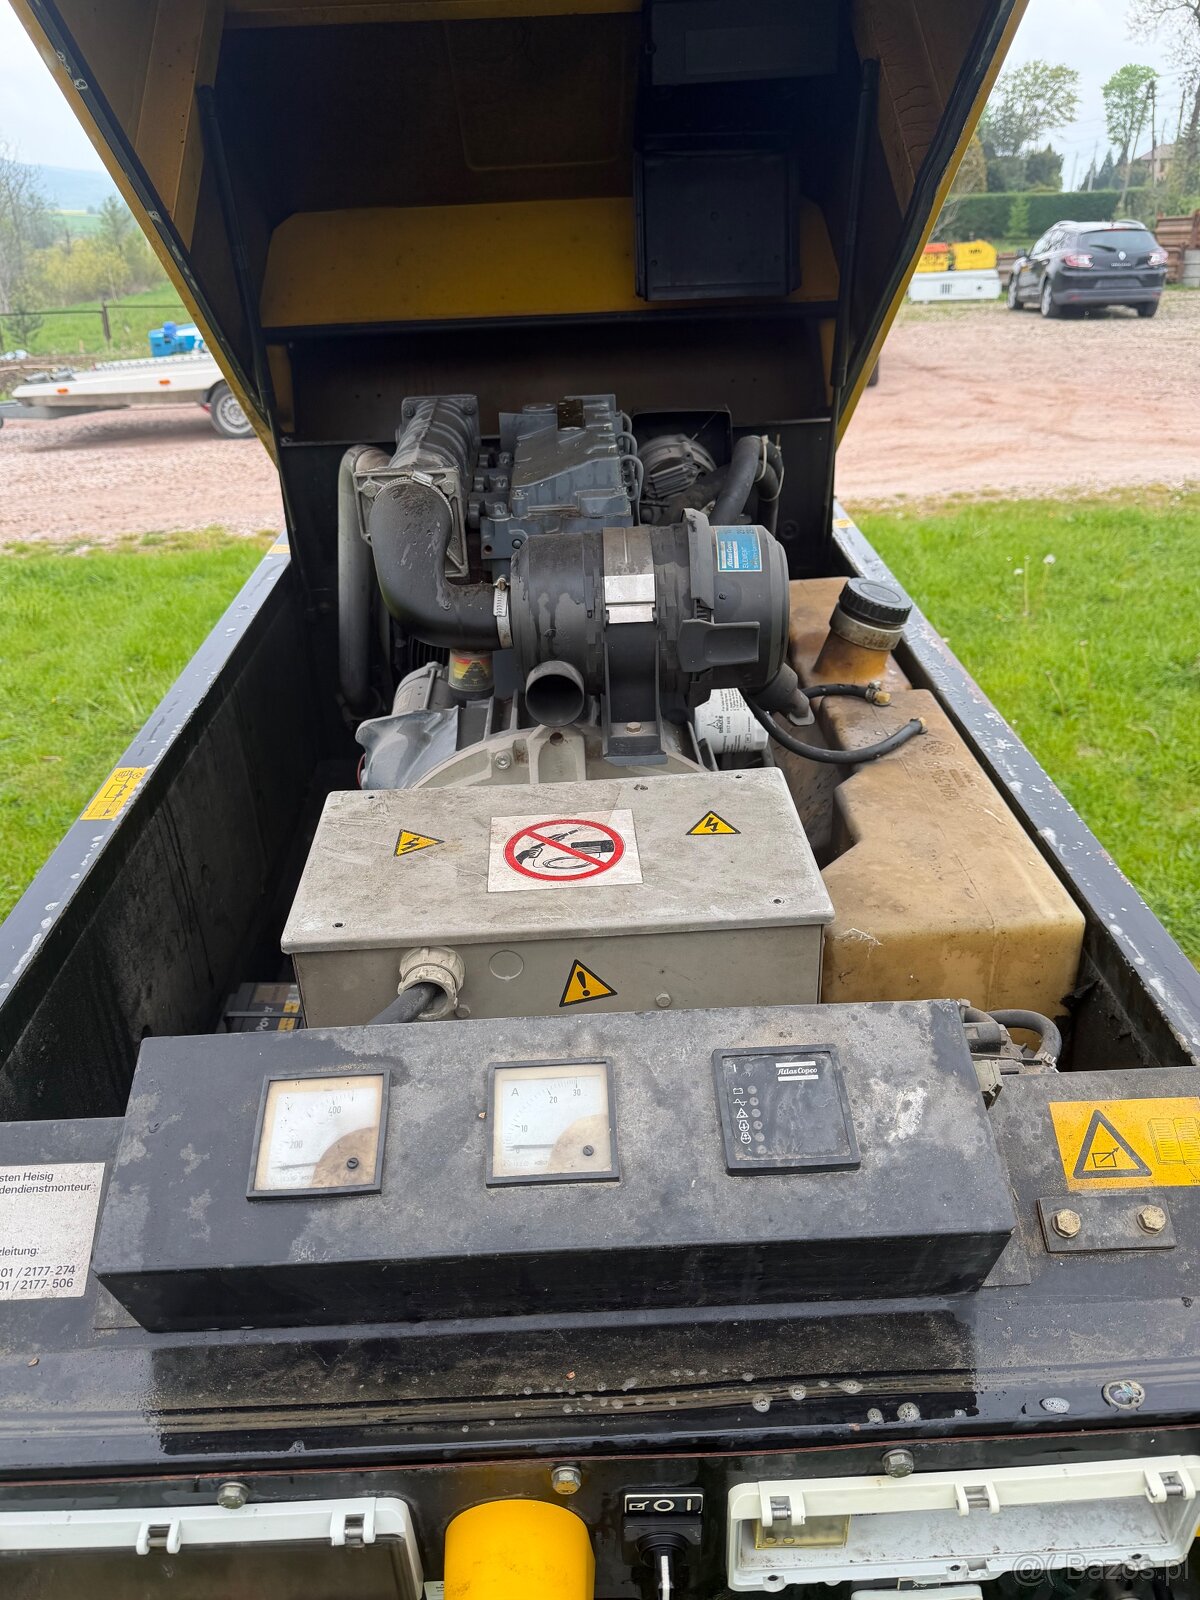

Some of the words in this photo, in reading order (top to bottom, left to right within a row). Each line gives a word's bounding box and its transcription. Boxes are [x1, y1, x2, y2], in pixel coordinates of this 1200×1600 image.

[510, 1087, 520, 1097] A
[572, 1088, 582, 1097] 30
[549, 1096, 558, 1104] 20
[327, 1105, 342, 1115] 400
[521, 1124, 528, 1133] 10
[289, 1140, 304, 1150] 200
[0, 1174, 21, 1182] sten
[23, 1171, 54, 1183] Heisig
[0, 1183, 92, 1194] dendienstmonteur
[0, 1267, 14, 1278] 01
